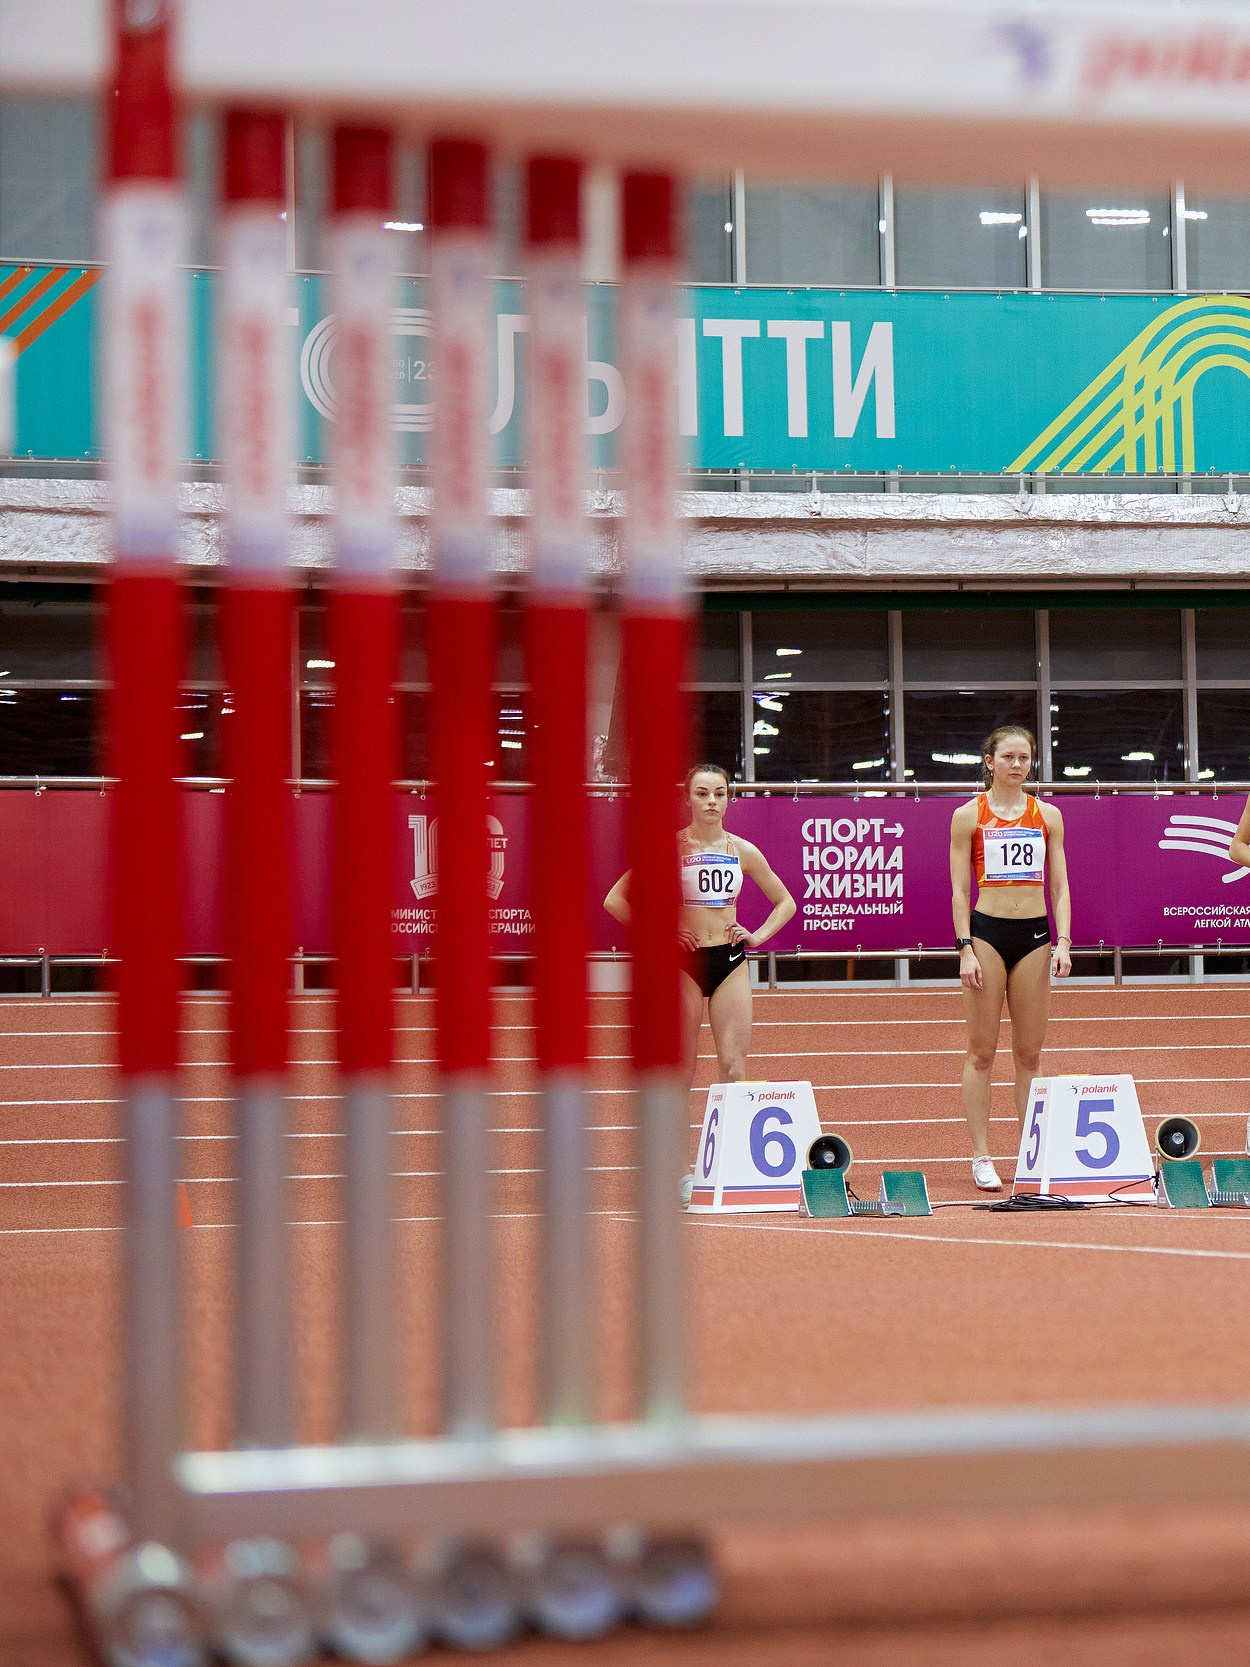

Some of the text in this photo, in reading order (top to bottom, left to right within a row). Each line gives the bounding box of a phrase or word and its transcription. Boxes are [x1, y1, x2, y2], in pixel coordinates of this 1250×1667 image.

[801, 818, 885, 843] СПОРТ
[802, 846, 903, 871] НОРМА
[1000, 843, 1034, 866] 128
[698, 868, 734, 893] 602
[803, 873, 904, 899] ЖИЗНИ
[488, 909, 532, 920] СПОРТА
[802, 900, 904, 917] ФЕДЕРАЛЬНЫЙ
[803, 919, 855, 931] ПРОЕКТ
[1193, 917, 1232, 928] ЛЕГКОЙ
[757, 1090, 796, 1102] polanik
[1081, 1084, 1119, 1095] polanik
[703, 1107, 719, 1179] 6
[749, 1106, 797, 1178] 6
[1026, 1100, 1045, 1171] 5
[1074, 1098, 1120, 1169] 5
